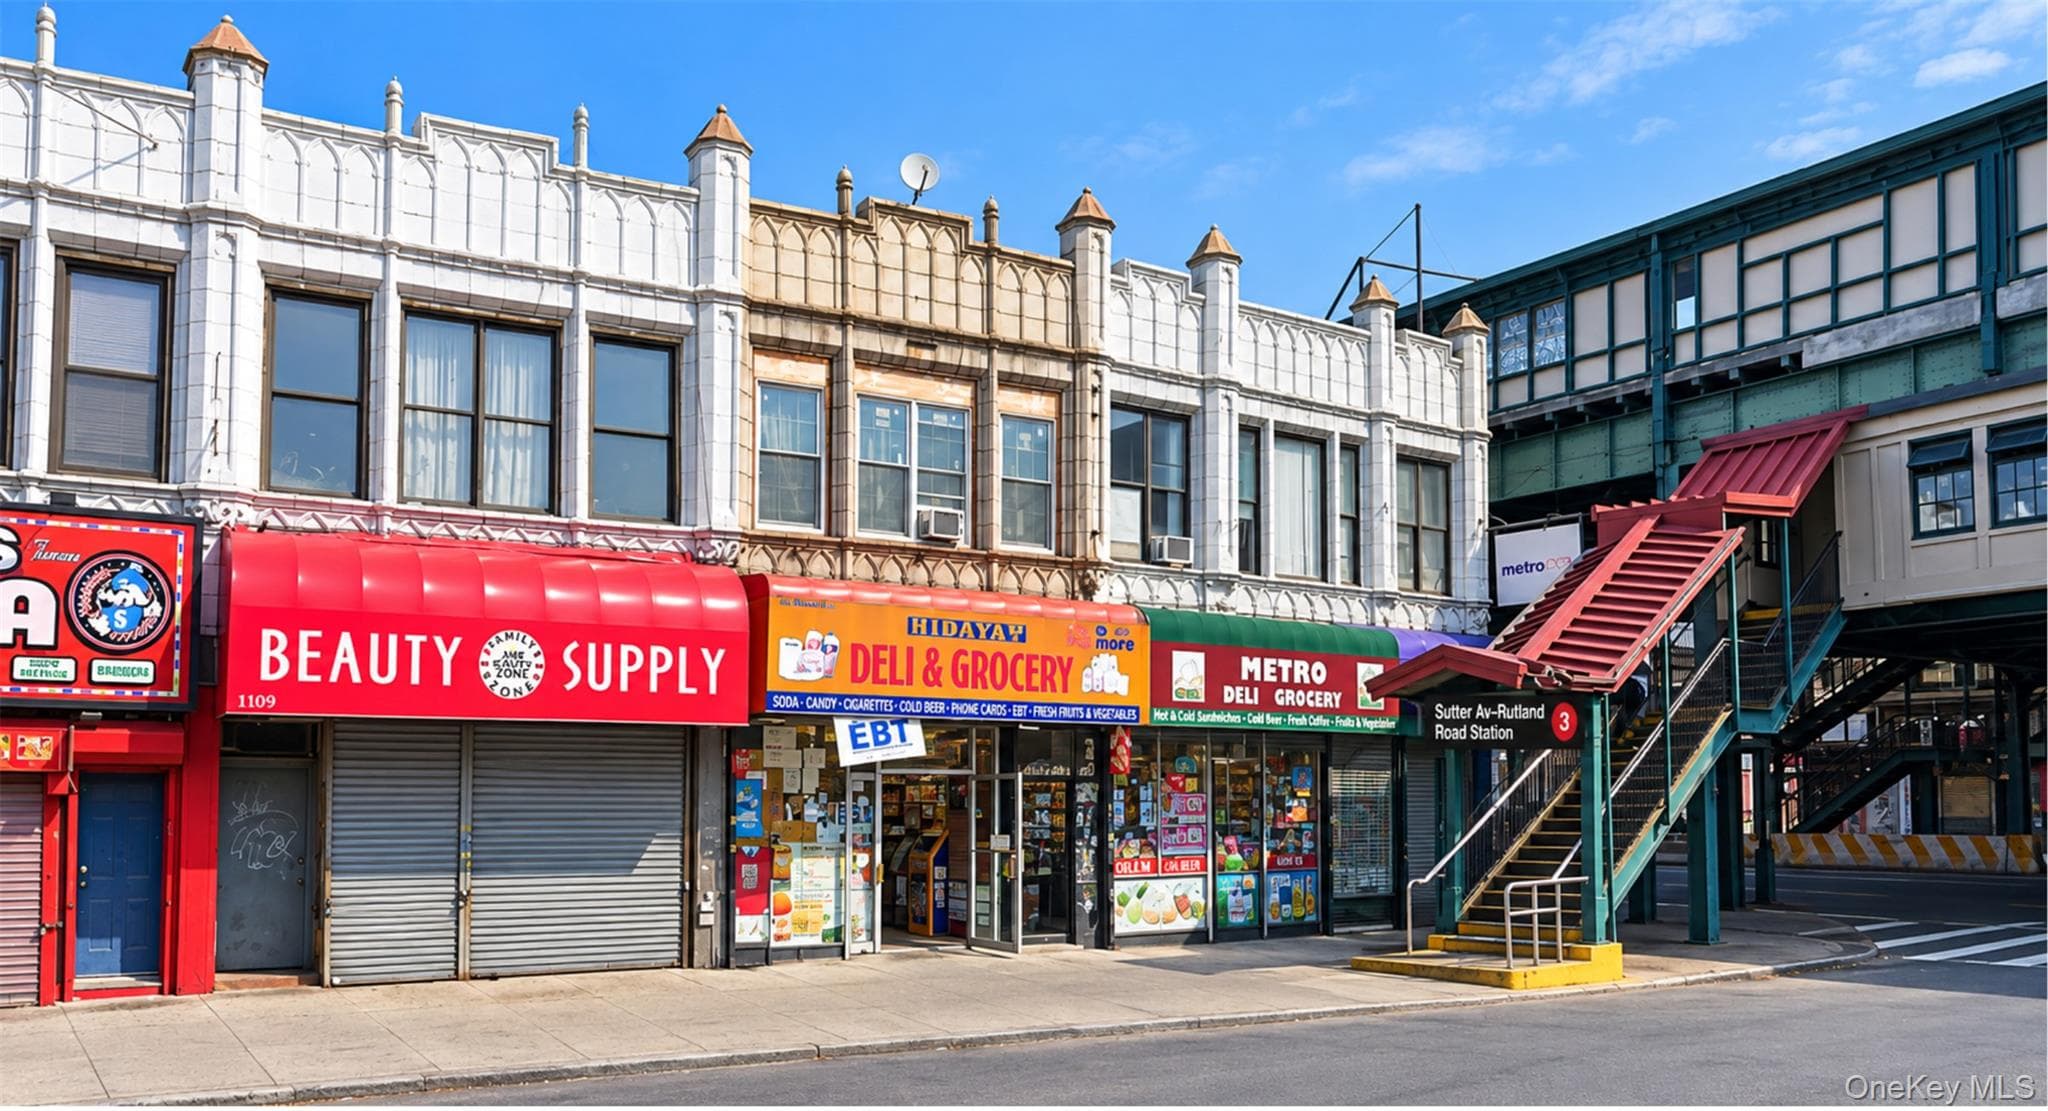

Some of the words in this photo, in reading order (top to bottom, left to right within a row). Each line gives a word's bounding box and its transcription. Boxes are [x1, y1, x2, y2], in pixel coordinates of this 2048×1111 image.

[1096, 638, 1135, 652] more
[260, 628, 462, 687] BEAUTY
[563, 640, 726, 695] SUPPLY
[850, 643, 914, 686] DELI
[922, 647, 943, 688] &
[951, 648, 1074, 694] GROCERY
[1241, 655, 1328, 685] METRO
[496, 668, 529, 679] ZONE
[238, 693, 276, 709] 1109
[772, 695, 799, 708] SODA
[806, 696, 838, 709] CANDY
[900, 700, 922, 713] COLD
[924, 702, 945, 714] BEER
[951, 702, 979, 716] PHONE
[981, 703, 1007, 717] CARDS
[1013, 704, 1028, 717] EBT
[1033, 705, 1057, 718] FRESH
[1085, 707, 1092, 719] &
[1223, 685, 1259, 705] DELI
[1274, 688, 1342, 709] GROCERY
[1153, 708, 1169, 721] Hot
[1178, 709, 1195, 721] Cold
[1247, 712, 1264, 724] Cold
[1434, 703, 1472, 719] Sutter
[1559, 711, 1570, 732] 3
[848, 718, 909, 750] EBT
[1435, 723, 1467, 740] Road
[1470, 723, 1514, 740] Station
